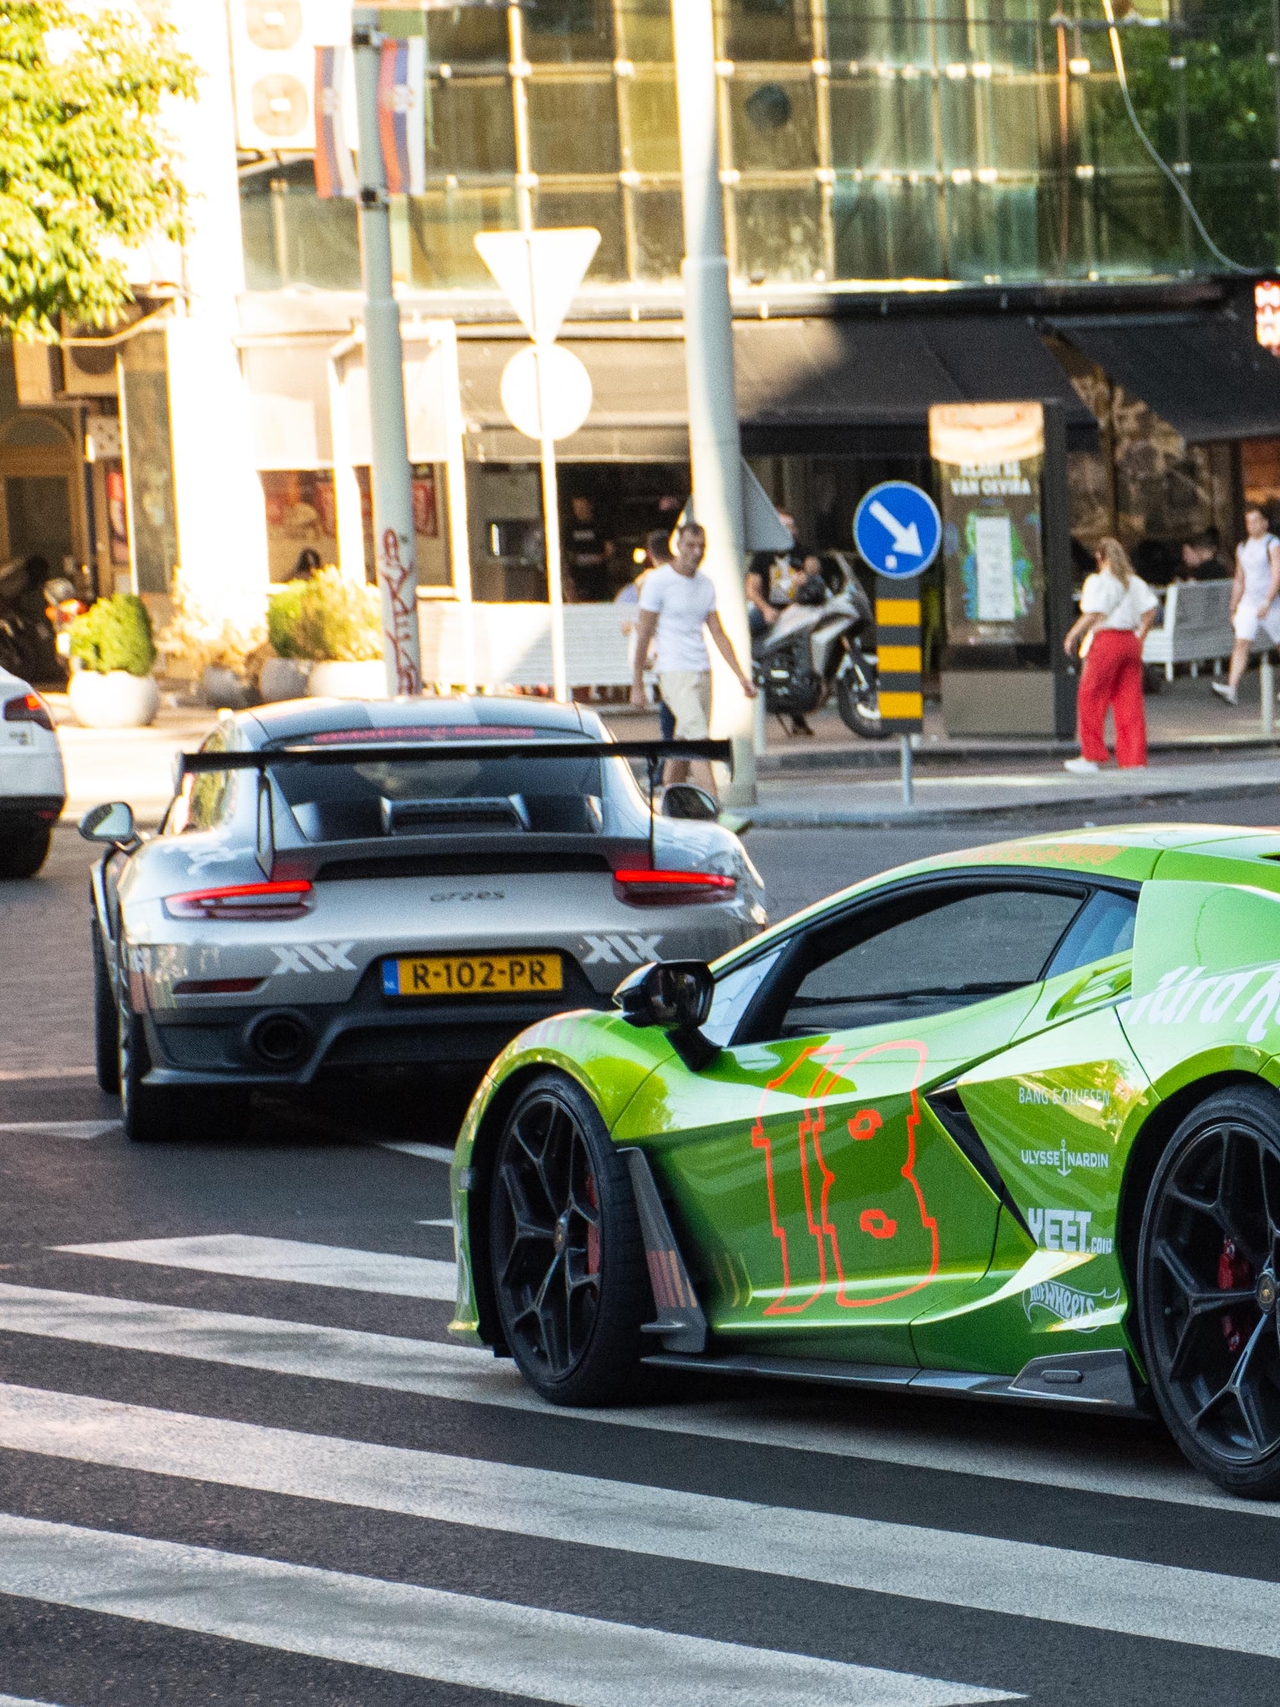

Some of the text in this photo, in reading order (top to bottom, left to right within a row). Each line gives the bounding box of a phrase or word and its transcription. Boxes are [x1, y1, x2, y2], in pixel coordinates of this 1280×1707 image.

[411, 961, 546, 989] R-102-PR
[1018, 1086, 1048, 1105] BANG
[1021, 1149, 1109, 1168] ULYSSE NARDIN
